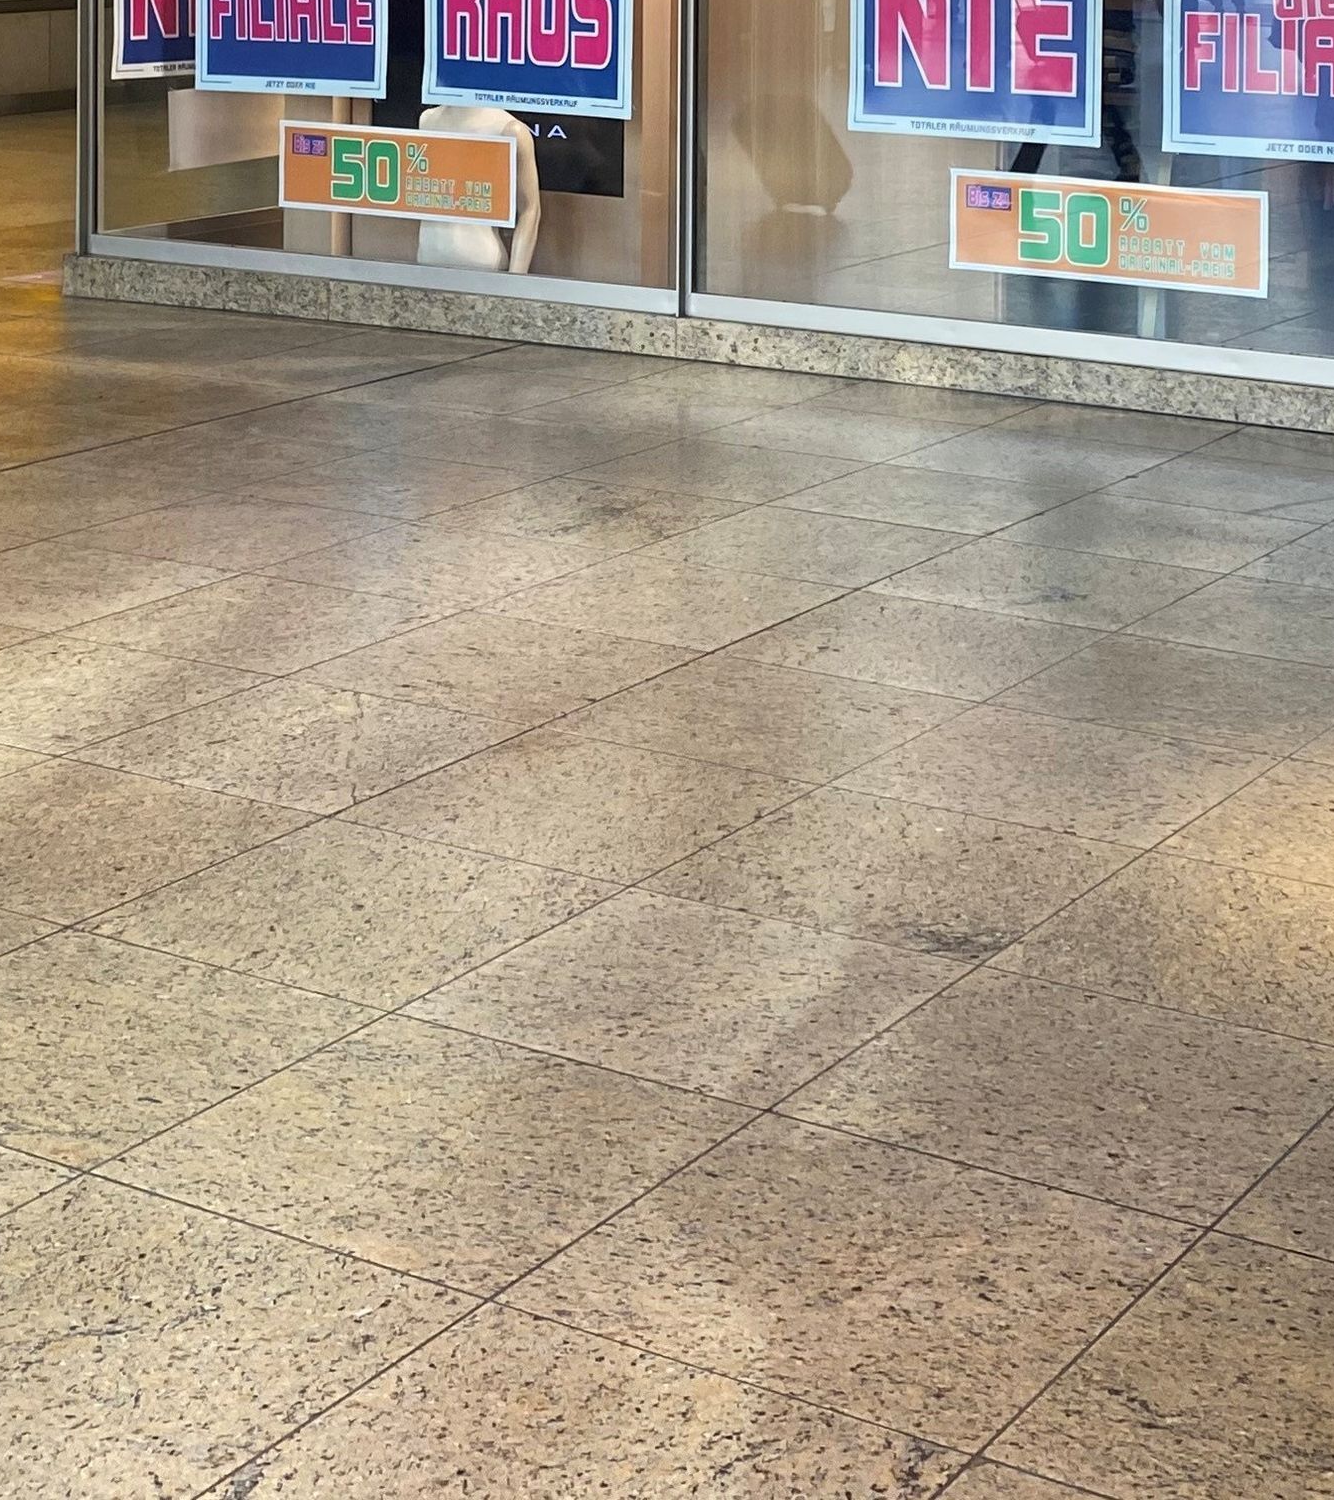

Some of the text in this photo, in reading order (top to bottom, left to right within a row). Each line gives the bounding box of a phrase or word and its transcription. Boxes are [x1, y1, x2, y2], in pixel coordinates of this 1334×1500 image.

[331, 136, 428, 204] 50 %
[1265, 142, 1296, 154] JETZT
[1298, 144, 1324, 155] ODER
[1018, 187, 1148, 267] 50 %
[1119, 235, 1236, 261] RABATT VOM
